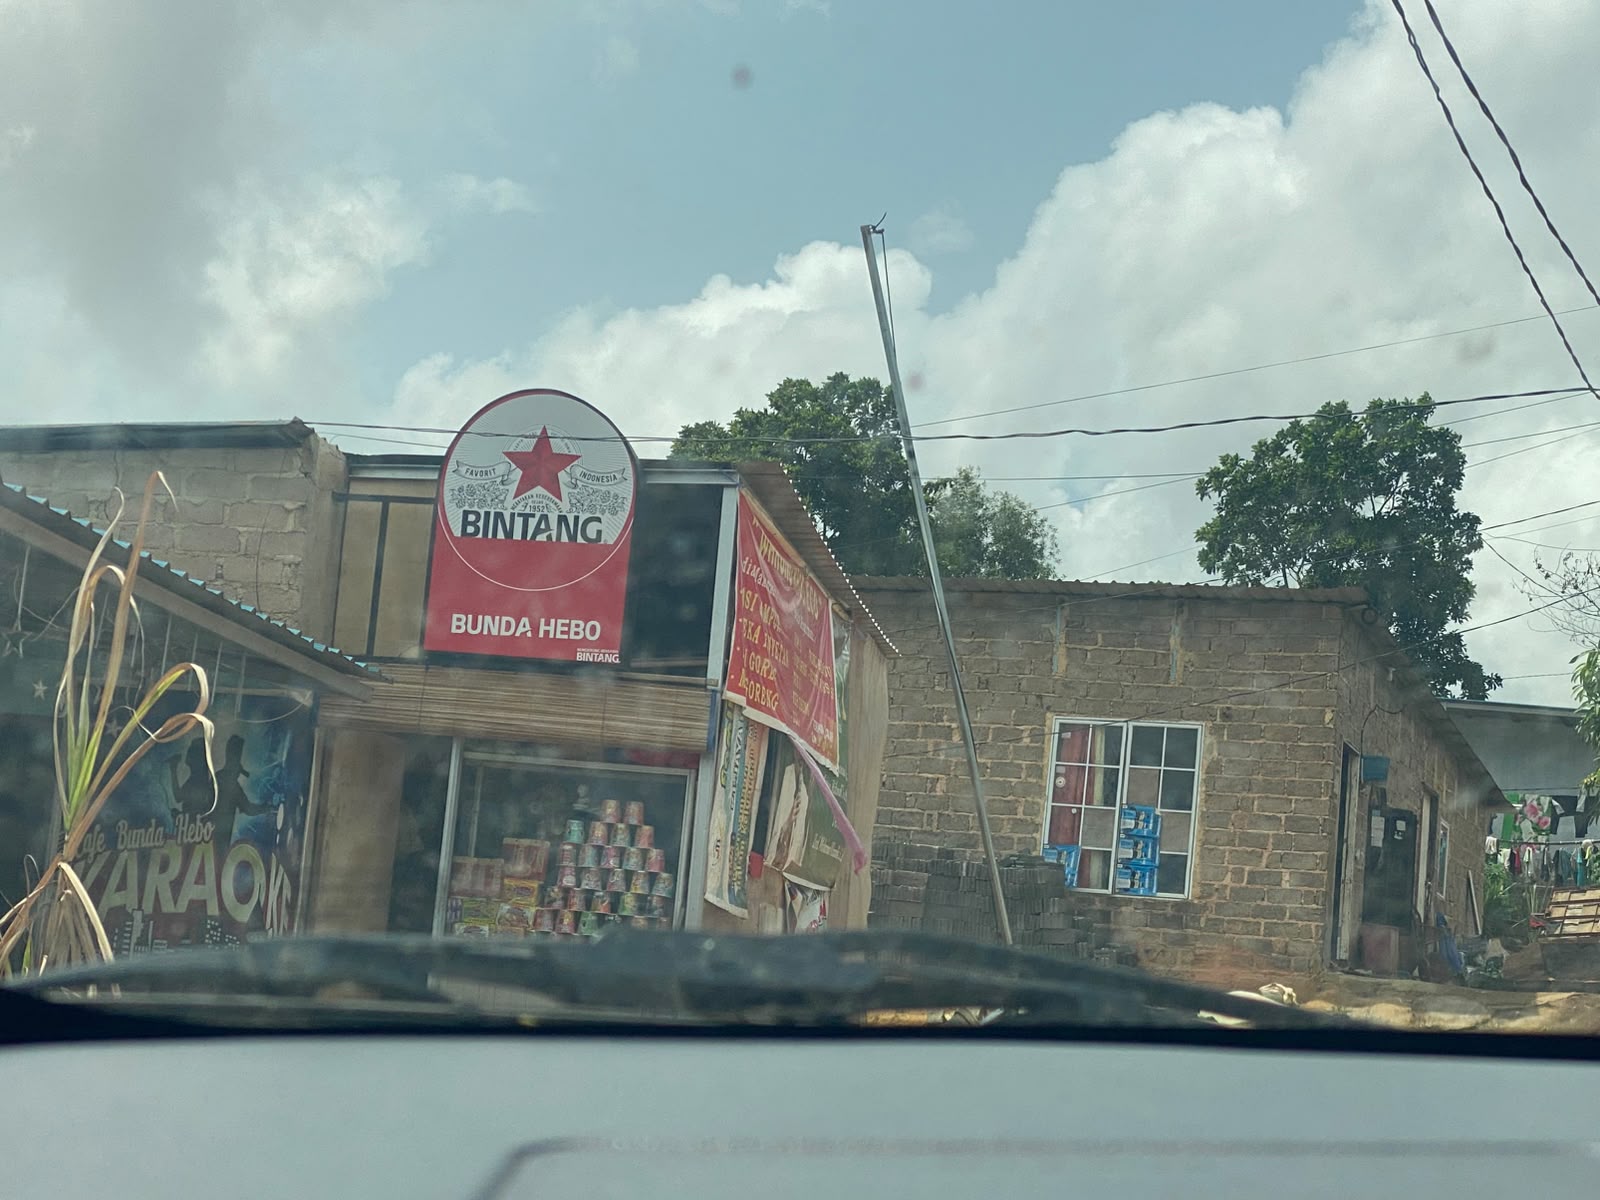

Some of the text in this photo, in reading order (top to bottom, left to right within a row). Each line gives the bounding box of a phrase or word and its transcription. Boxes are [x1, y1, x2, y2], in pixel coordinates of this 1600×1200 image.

[465, 467, 497, 477] FAVORIT
[579, 469, 618, 482] INDONESIA
[529, 504, 546, 513] 1952
[460, 509, 603, 544] BINTANG
[451, 613, 601, 641] BUNDA HEBO
[576, 652, 621, 663] BINTANG
[77, 813, 215, 863] afe Bunda Hebo
